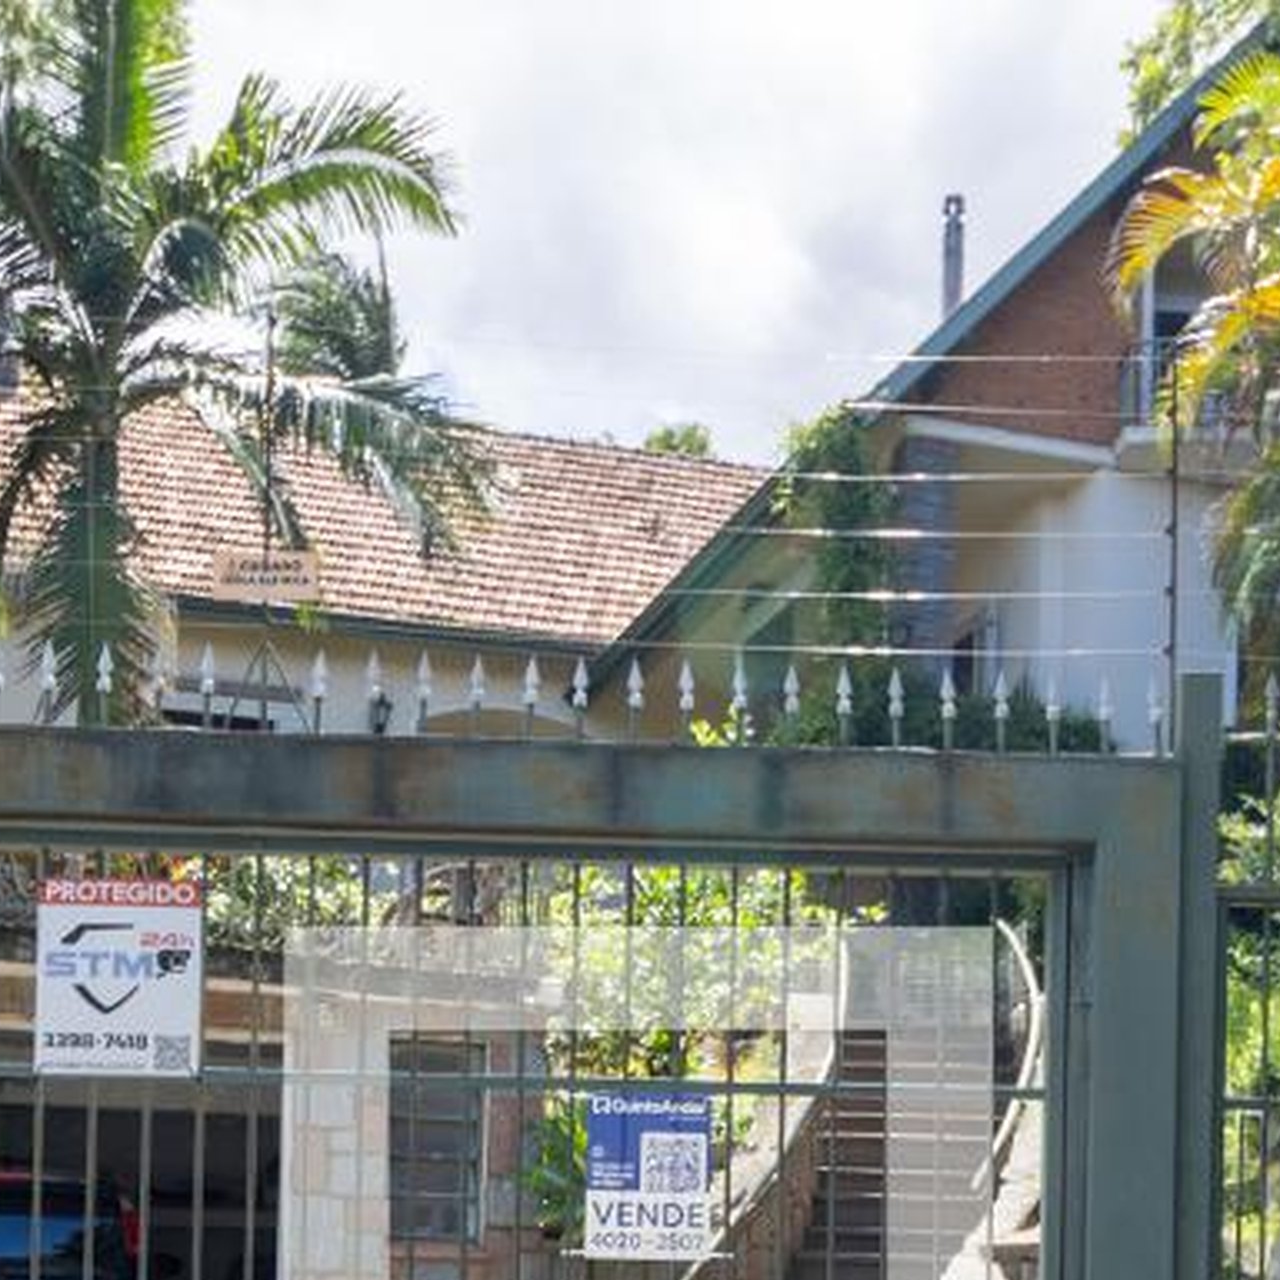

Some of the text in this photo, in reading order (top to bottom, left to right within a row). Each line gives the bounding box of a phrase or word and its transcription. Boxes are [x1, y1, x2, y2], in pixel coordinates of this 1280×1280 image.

[45, 880, 195, 903] PROTEGIDO
[44, 952, 154, 979] STM
[591, 1201, 705, 1229] VENDE
